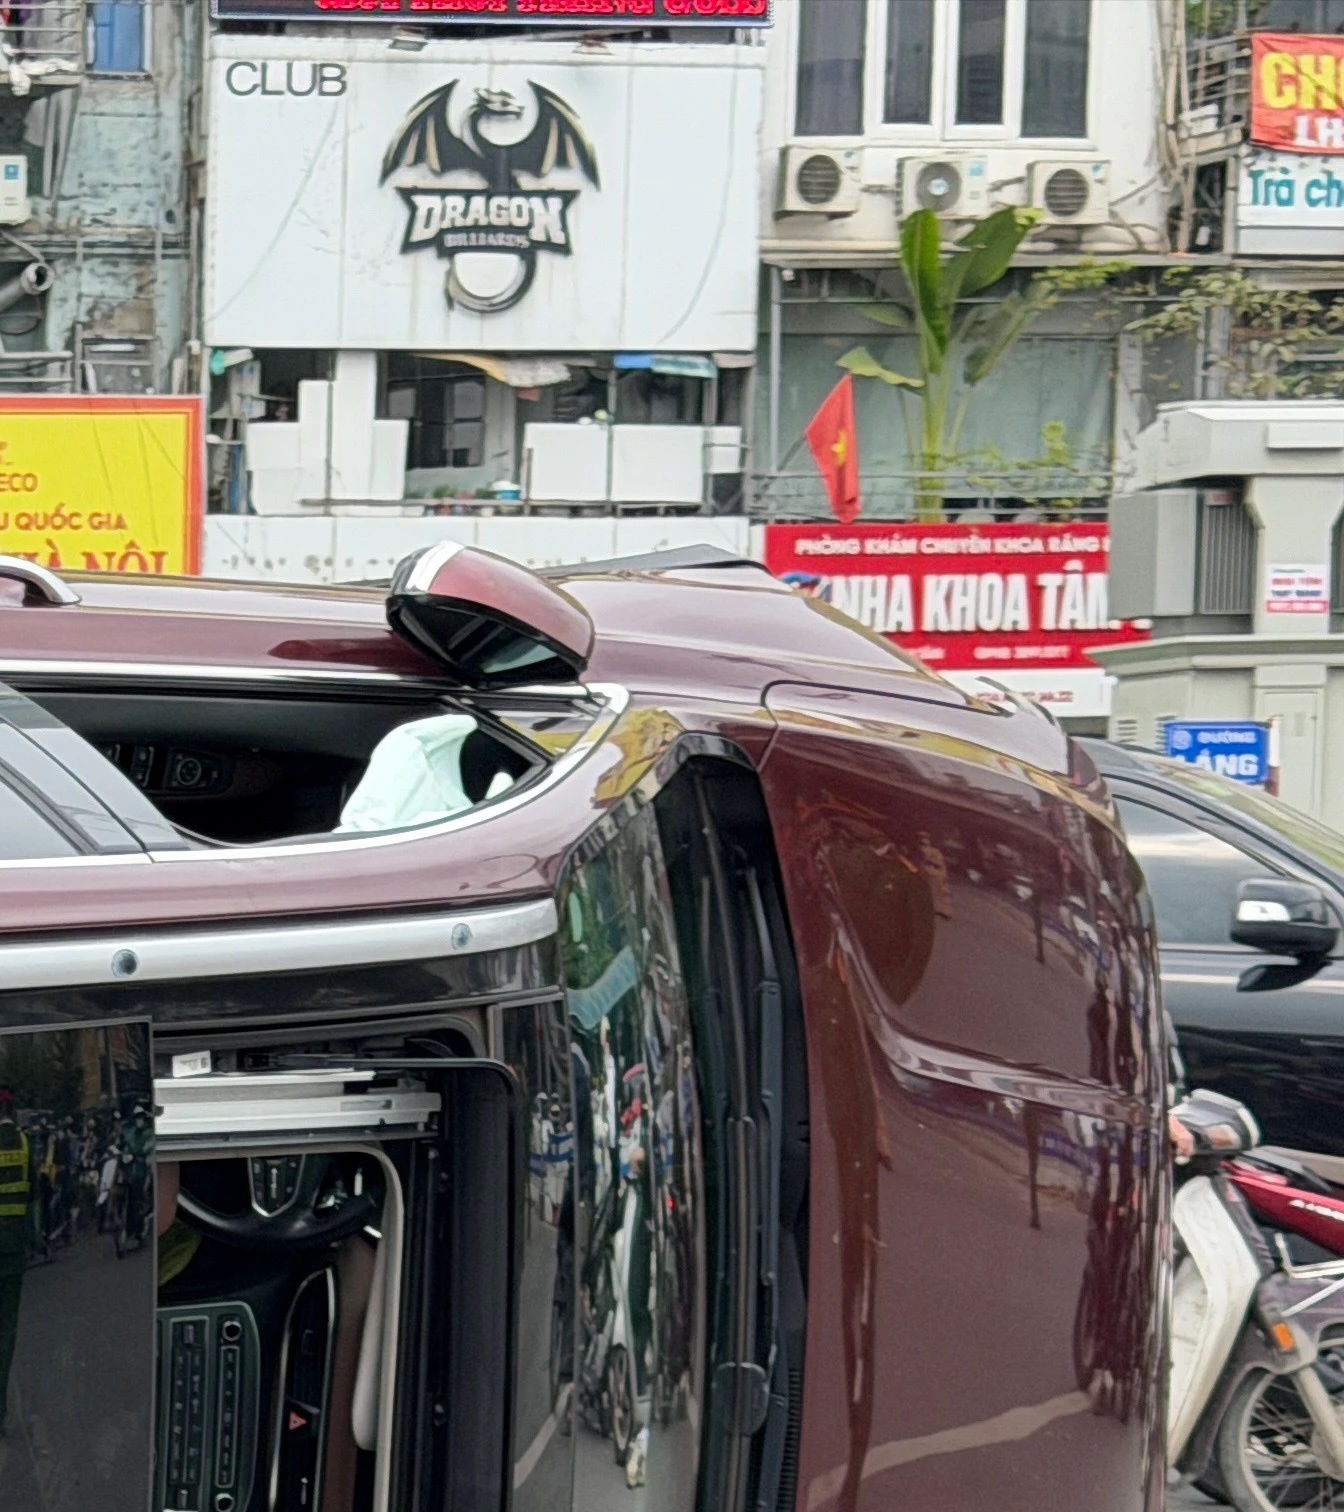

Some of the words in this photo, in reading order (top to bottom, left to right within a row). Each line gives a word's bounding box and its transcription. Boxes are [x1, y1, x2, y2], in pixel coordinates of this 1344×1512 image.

[226, 61, 347, 97] CLUB
[1261, 52, 1344, 110] CH
[1249, 167, 1295, 206] Trà
[410, 195, 566, 244] DRAGON
[15, 503, 82, 531] QUỐC
[88, 512, 127, 531] GIA
[831, 574, 912, 632] NHA
[923, 573, 1030, 631] KHOA
[1173, 749, 1259, 776] ÁNG
